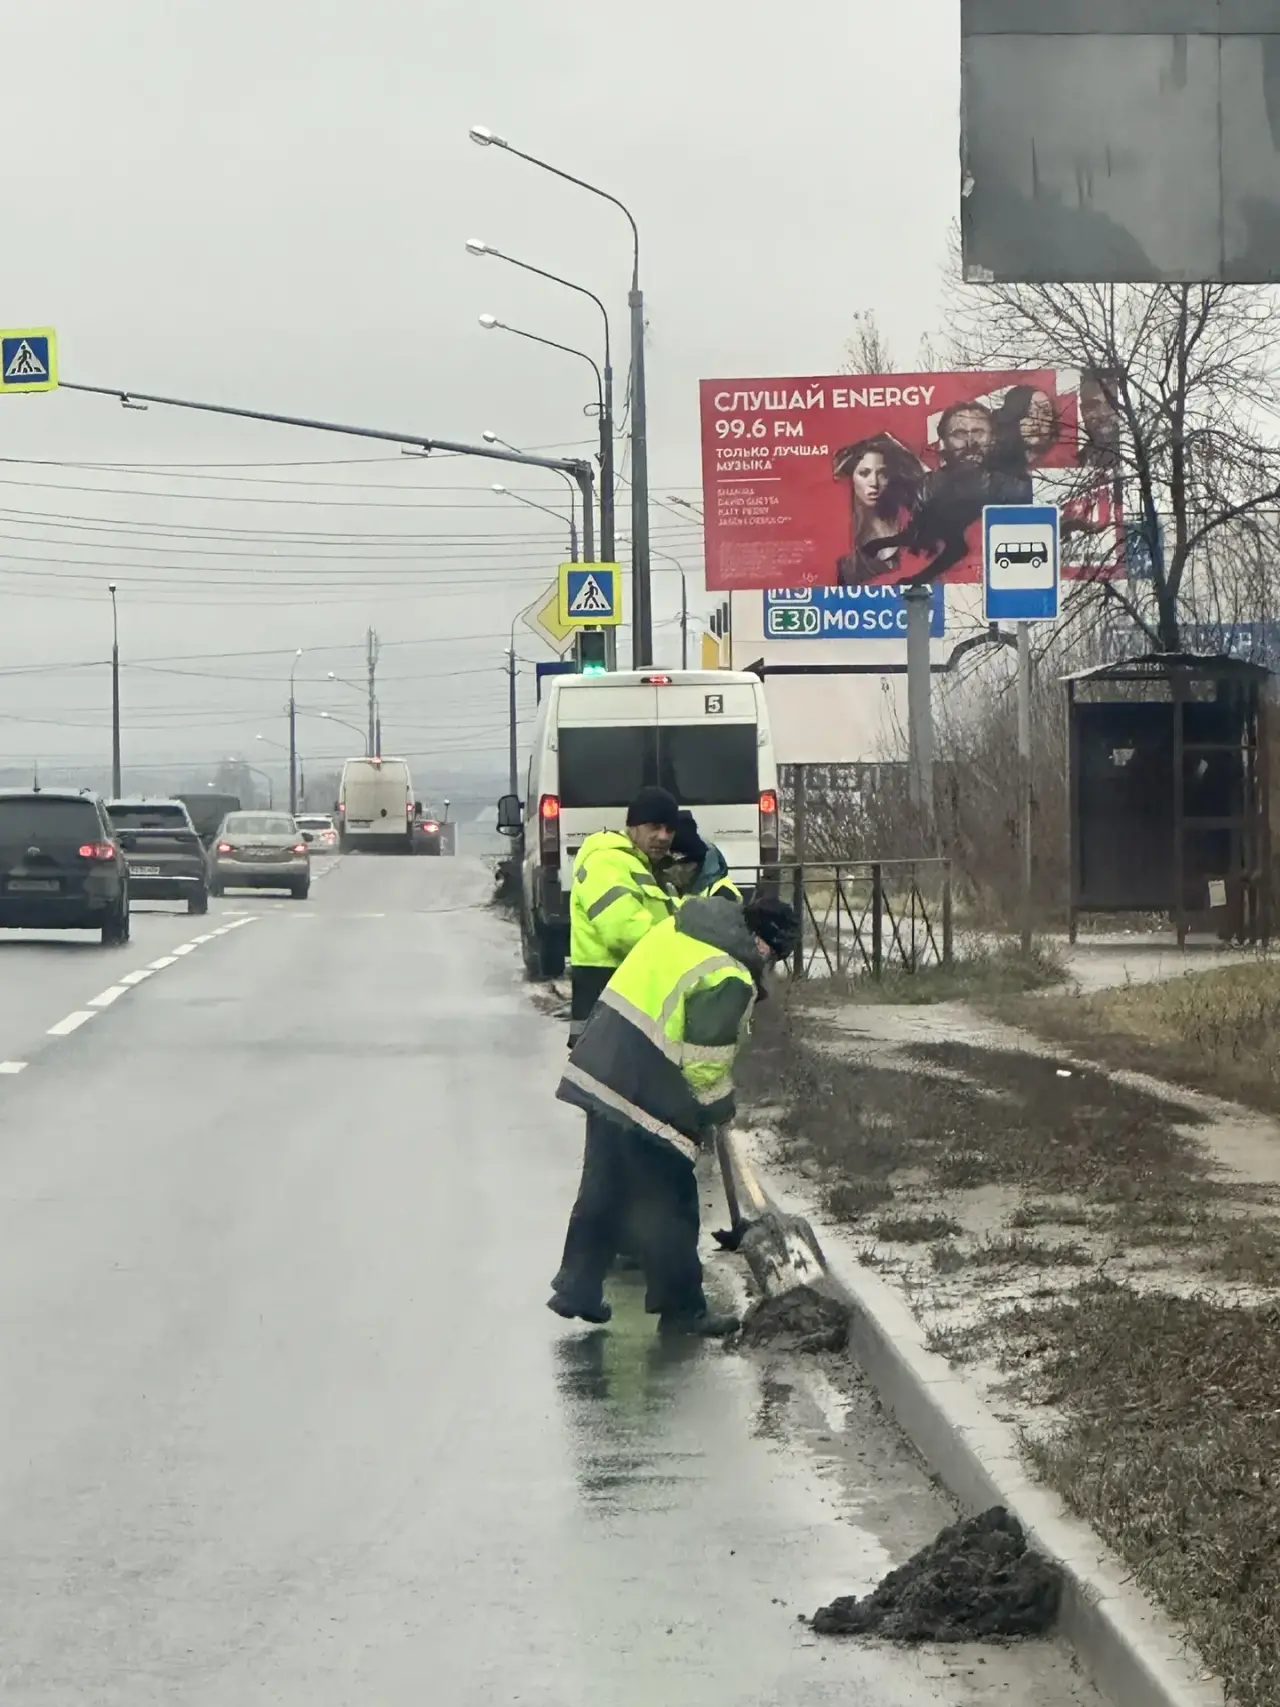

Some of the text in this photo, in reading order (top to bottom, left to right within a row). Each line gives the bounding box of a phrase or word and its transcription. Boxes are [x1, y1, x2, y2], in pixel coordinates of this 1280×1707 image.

[714, 383, 935, 412] СЛУШАЙ ENERGY
[714, 418, 804, 439] 99.6 FM
[716, 444, 828, 459] ТОЛЬКО ЛУЧШАЯ
[772, 609, 935, 631] E30 MOSCO
[707, 696, 721, 713] 5
